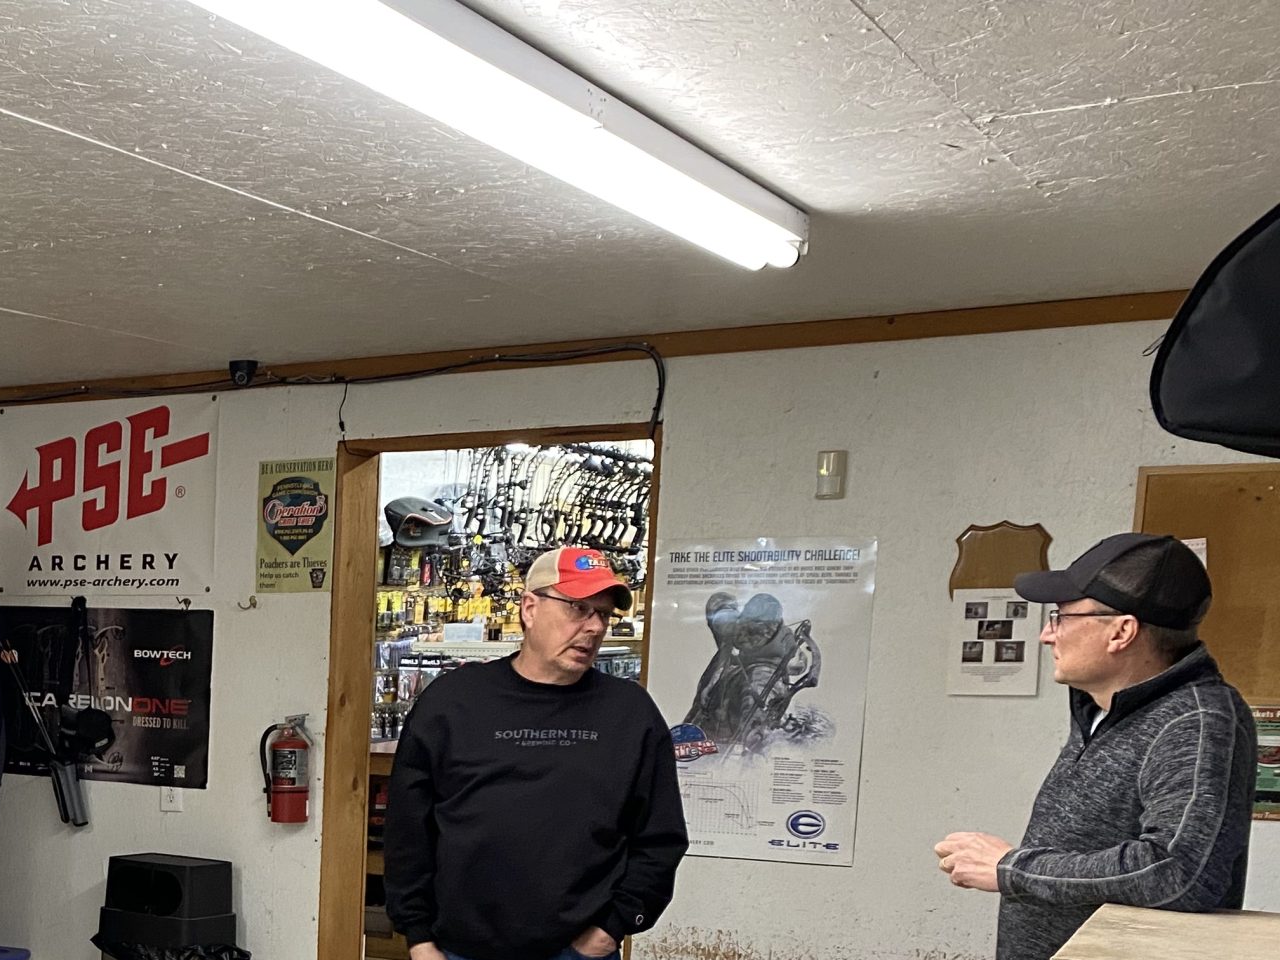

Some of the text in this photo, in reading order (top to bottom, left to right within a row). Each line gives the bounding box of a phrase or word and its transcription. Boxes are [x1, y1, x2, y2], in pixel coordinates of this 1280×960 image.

[275, 461, 317, 474] CONSERVATION
[318, 460, 334, 472] HERO
[35, 405, 171, 547] PSE
[264, 499, 325, 524] Operation
[28, 553, 179, 572] ARCHERY
[670, 549, 861, 563] TAKE THE ELITE SHOOTABILITY CHALLENGE!
[260, 557, 327, 569] Poachers are Thieves
[27, 576, 180, 589] www.pse-archery.com
[260, 572, 274, 580] Help
[134, 650, 191, 660] BOWTECH
[1252, 710, 1274, 718] skets
[133, 716, 161, 728] DRESSED
[163, 717, 171, 729] TO
[495, 729, 599, 741] SOUTHERN TIER
[768, 839, 839, 850] ELITE
